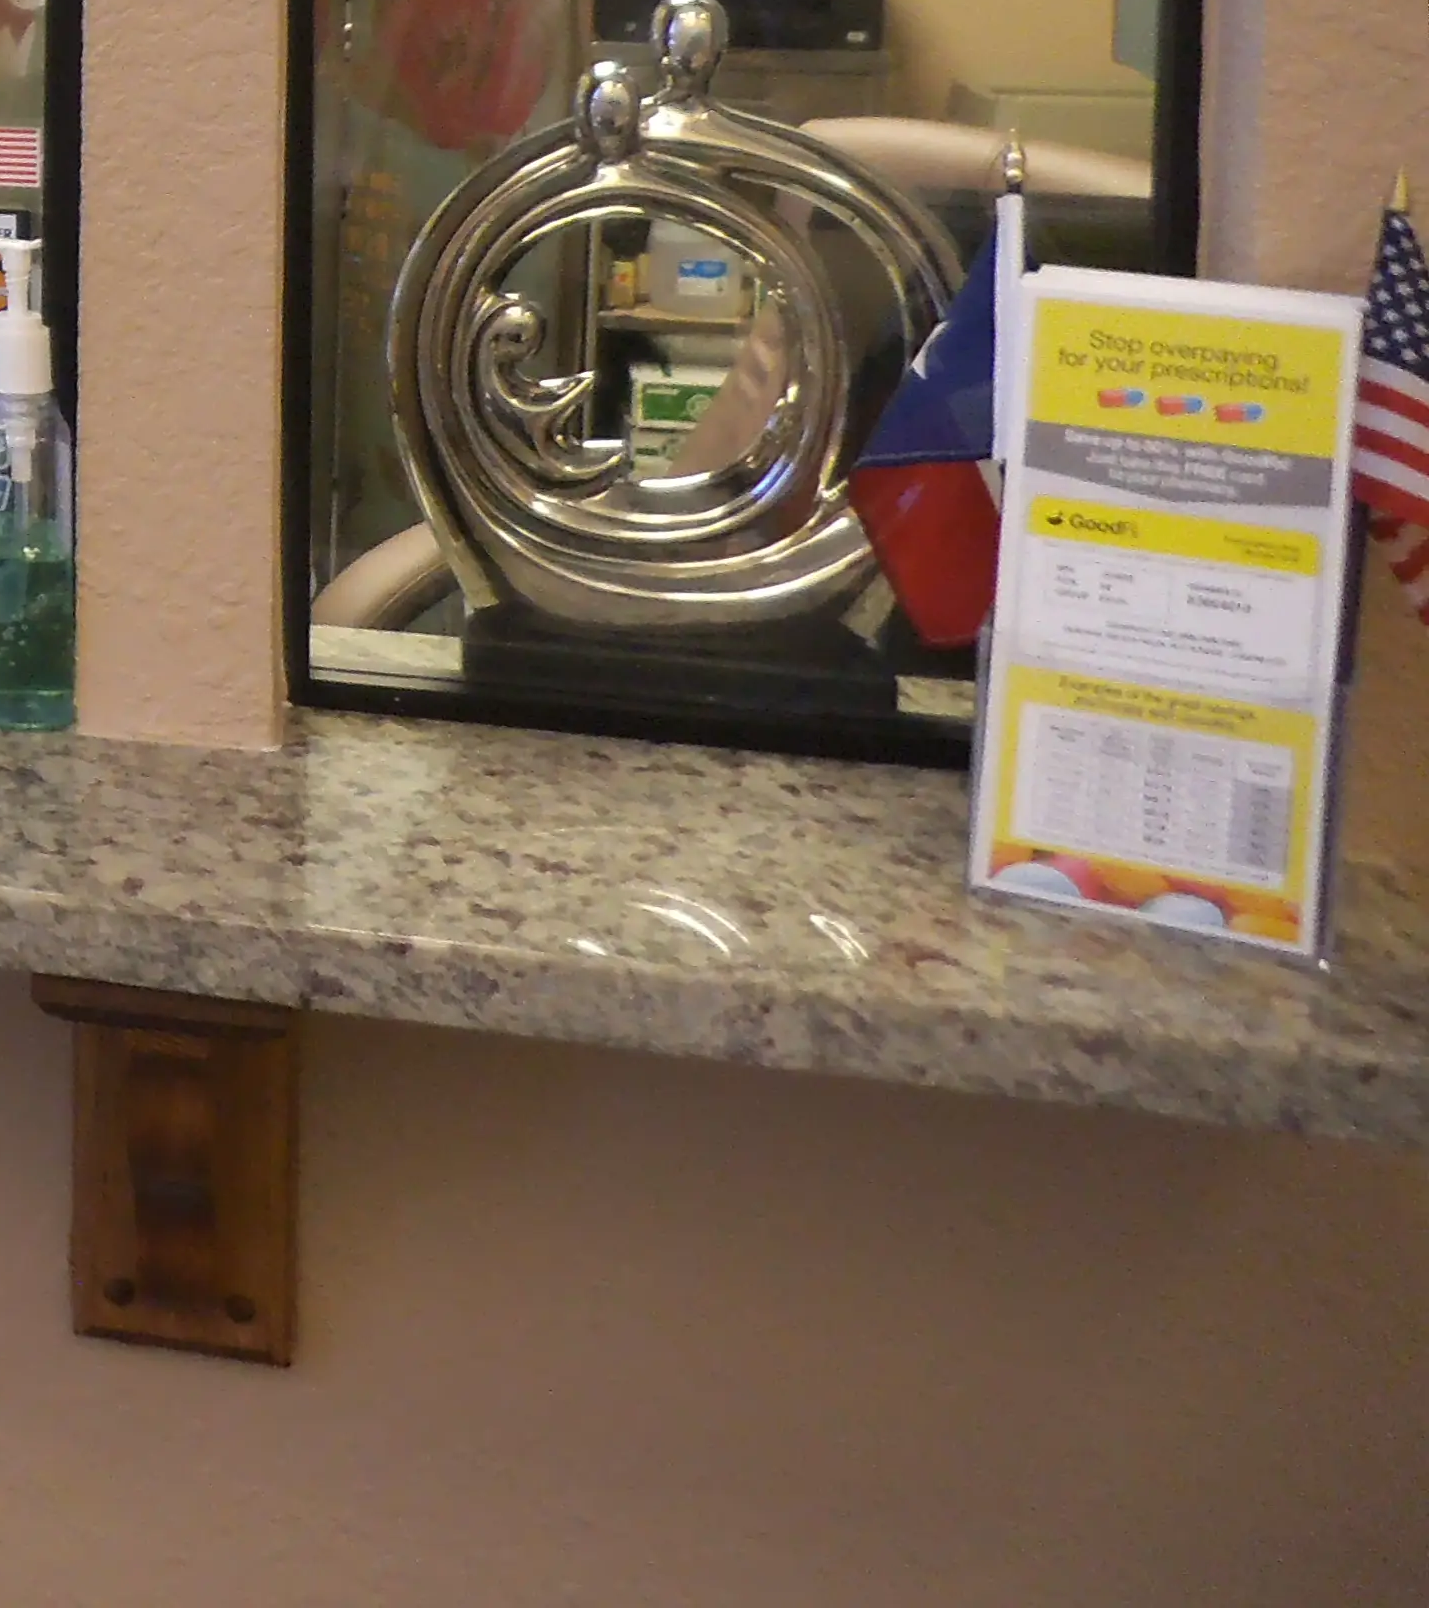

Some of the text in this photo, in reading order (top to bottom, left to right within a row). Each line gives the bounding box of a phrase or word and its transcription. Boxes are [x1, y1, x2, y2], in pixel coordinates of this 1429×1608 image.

[1058, 347, 1310, 394] for your prescriptions!
[1089, 328, 1280, 372] Stop overpaying
